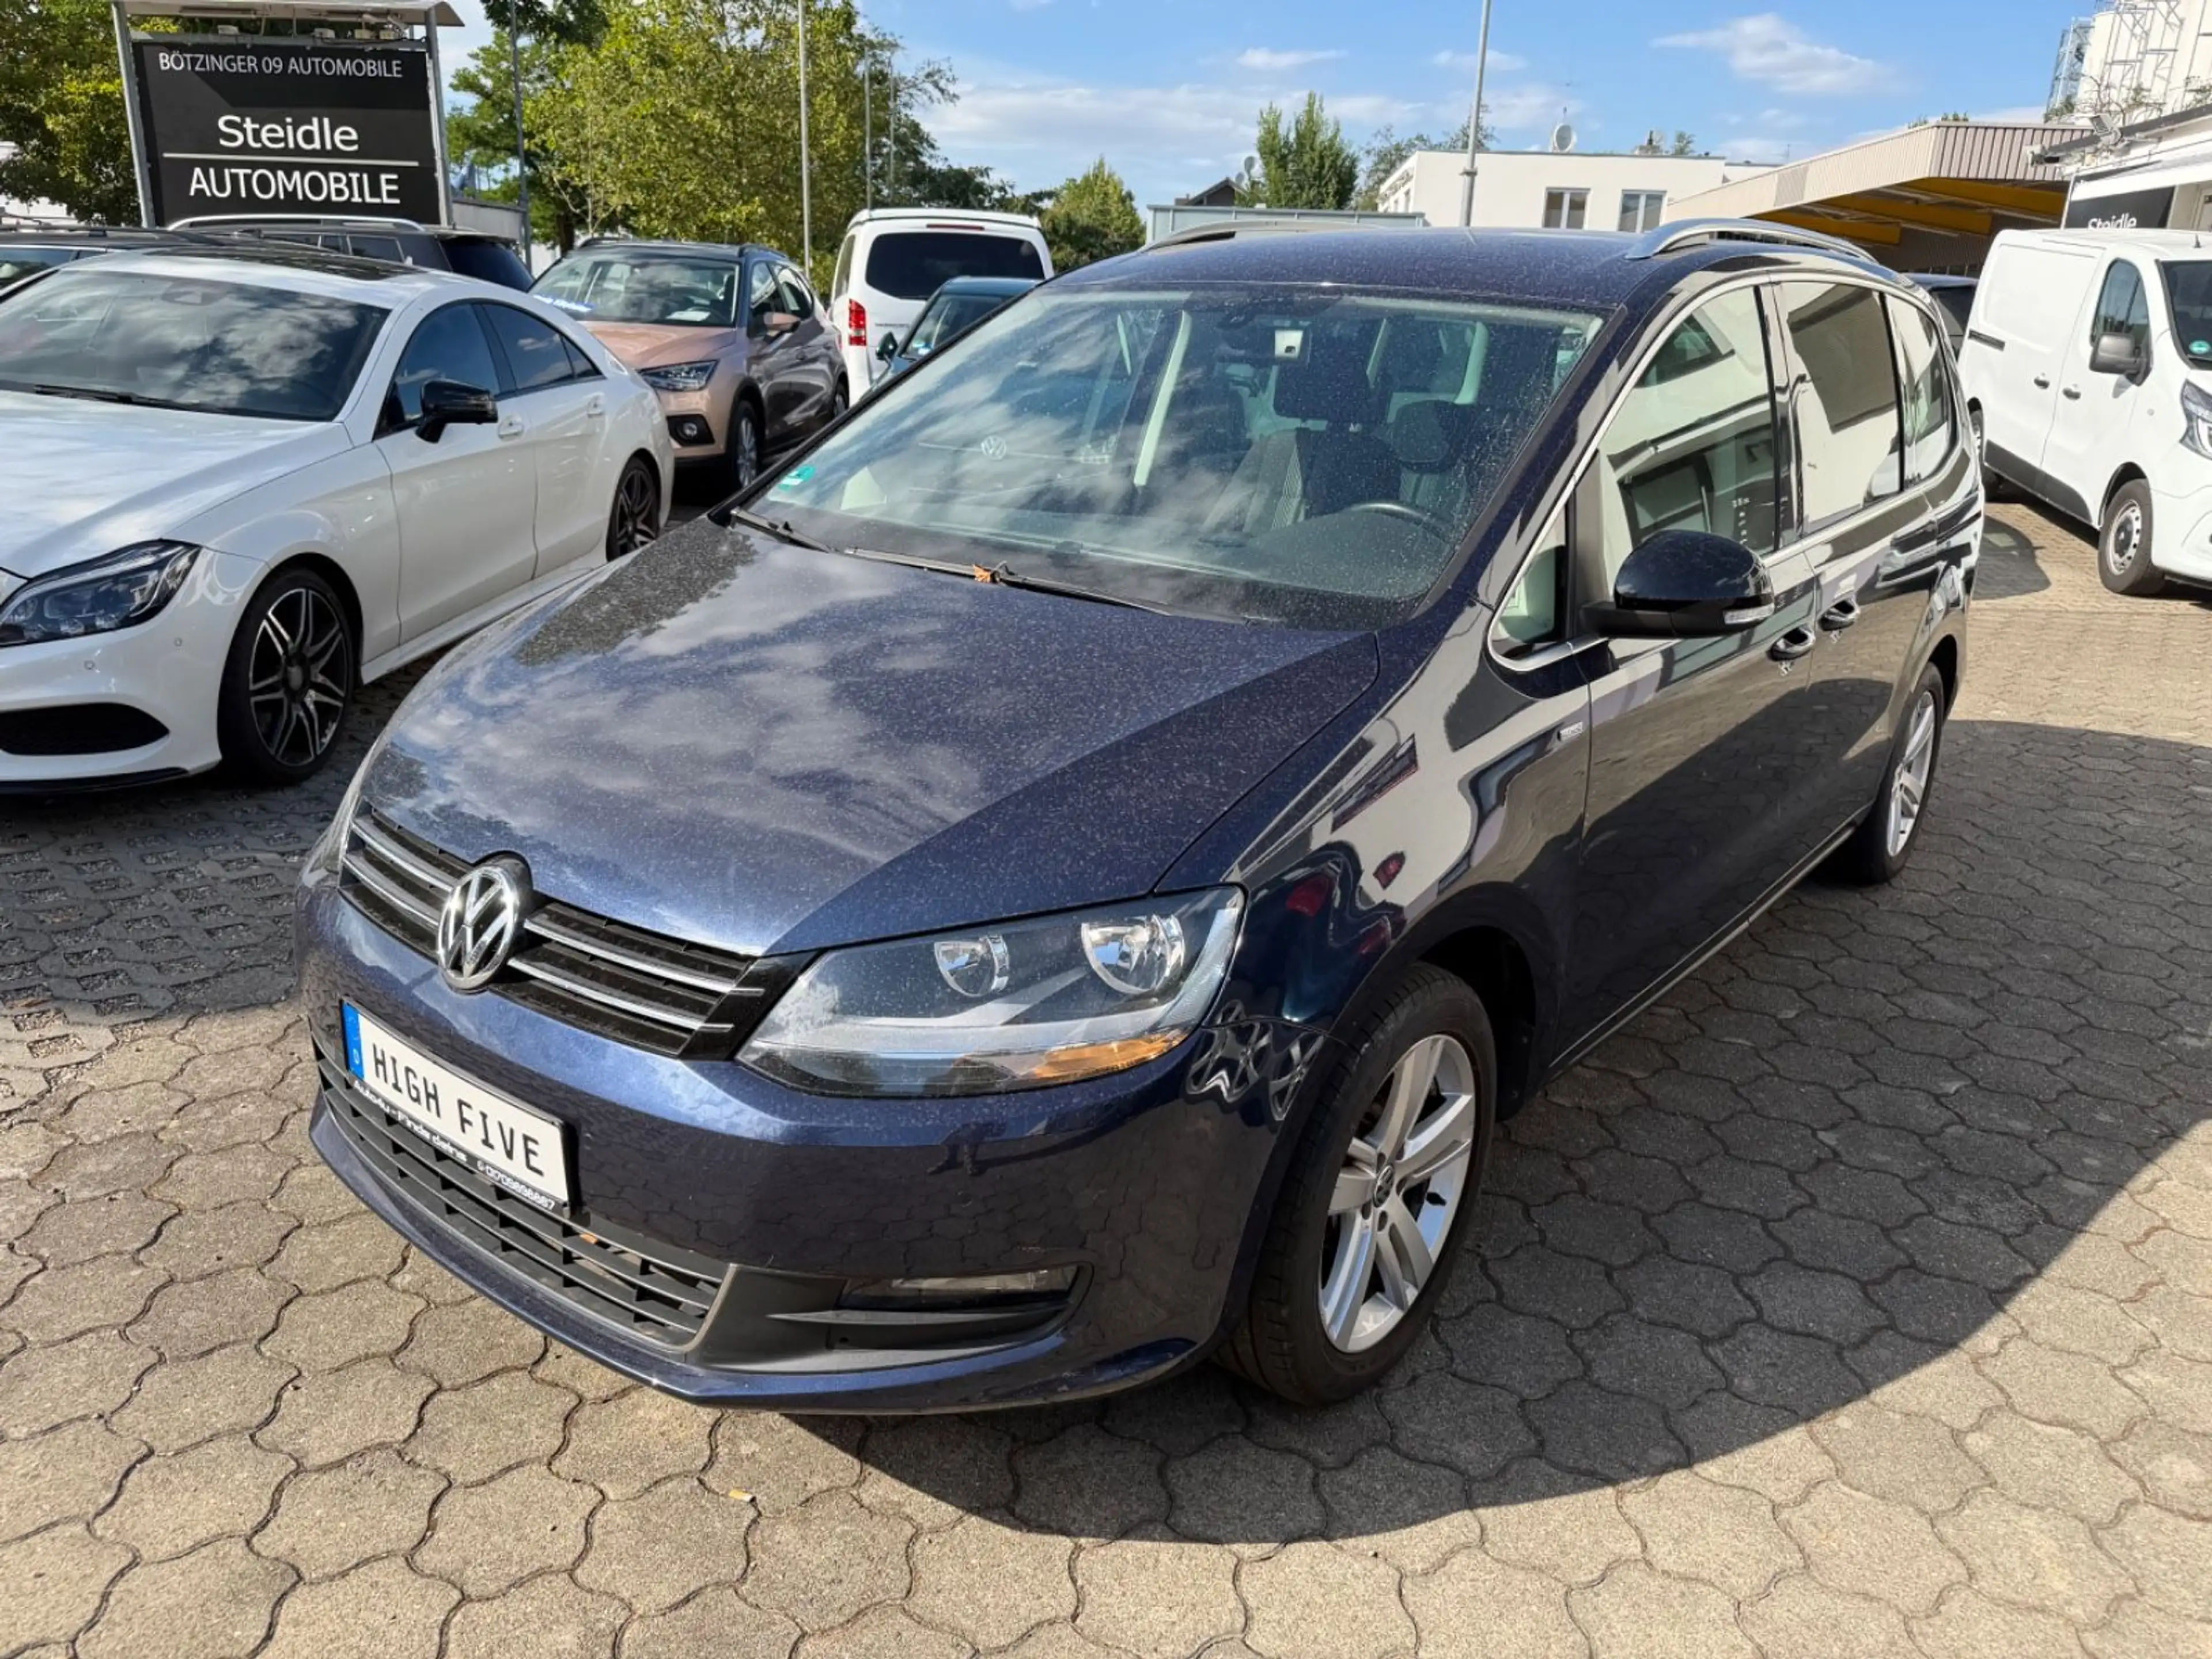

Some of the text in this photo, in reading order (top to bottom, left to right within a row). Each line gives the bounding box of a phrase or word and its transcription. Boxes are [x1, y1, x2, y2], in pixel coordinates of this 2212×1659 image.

[158, 51, 403, 78] BÖTZINGER 09 AUTOMOBILE
[218, 115, 358, 151] Steidle
[189, 167, 400, 204] AUTOMOBILE
[372, 1043, 441, 1119] HIGH
[457, 1098, 545, 1177] FIVE
